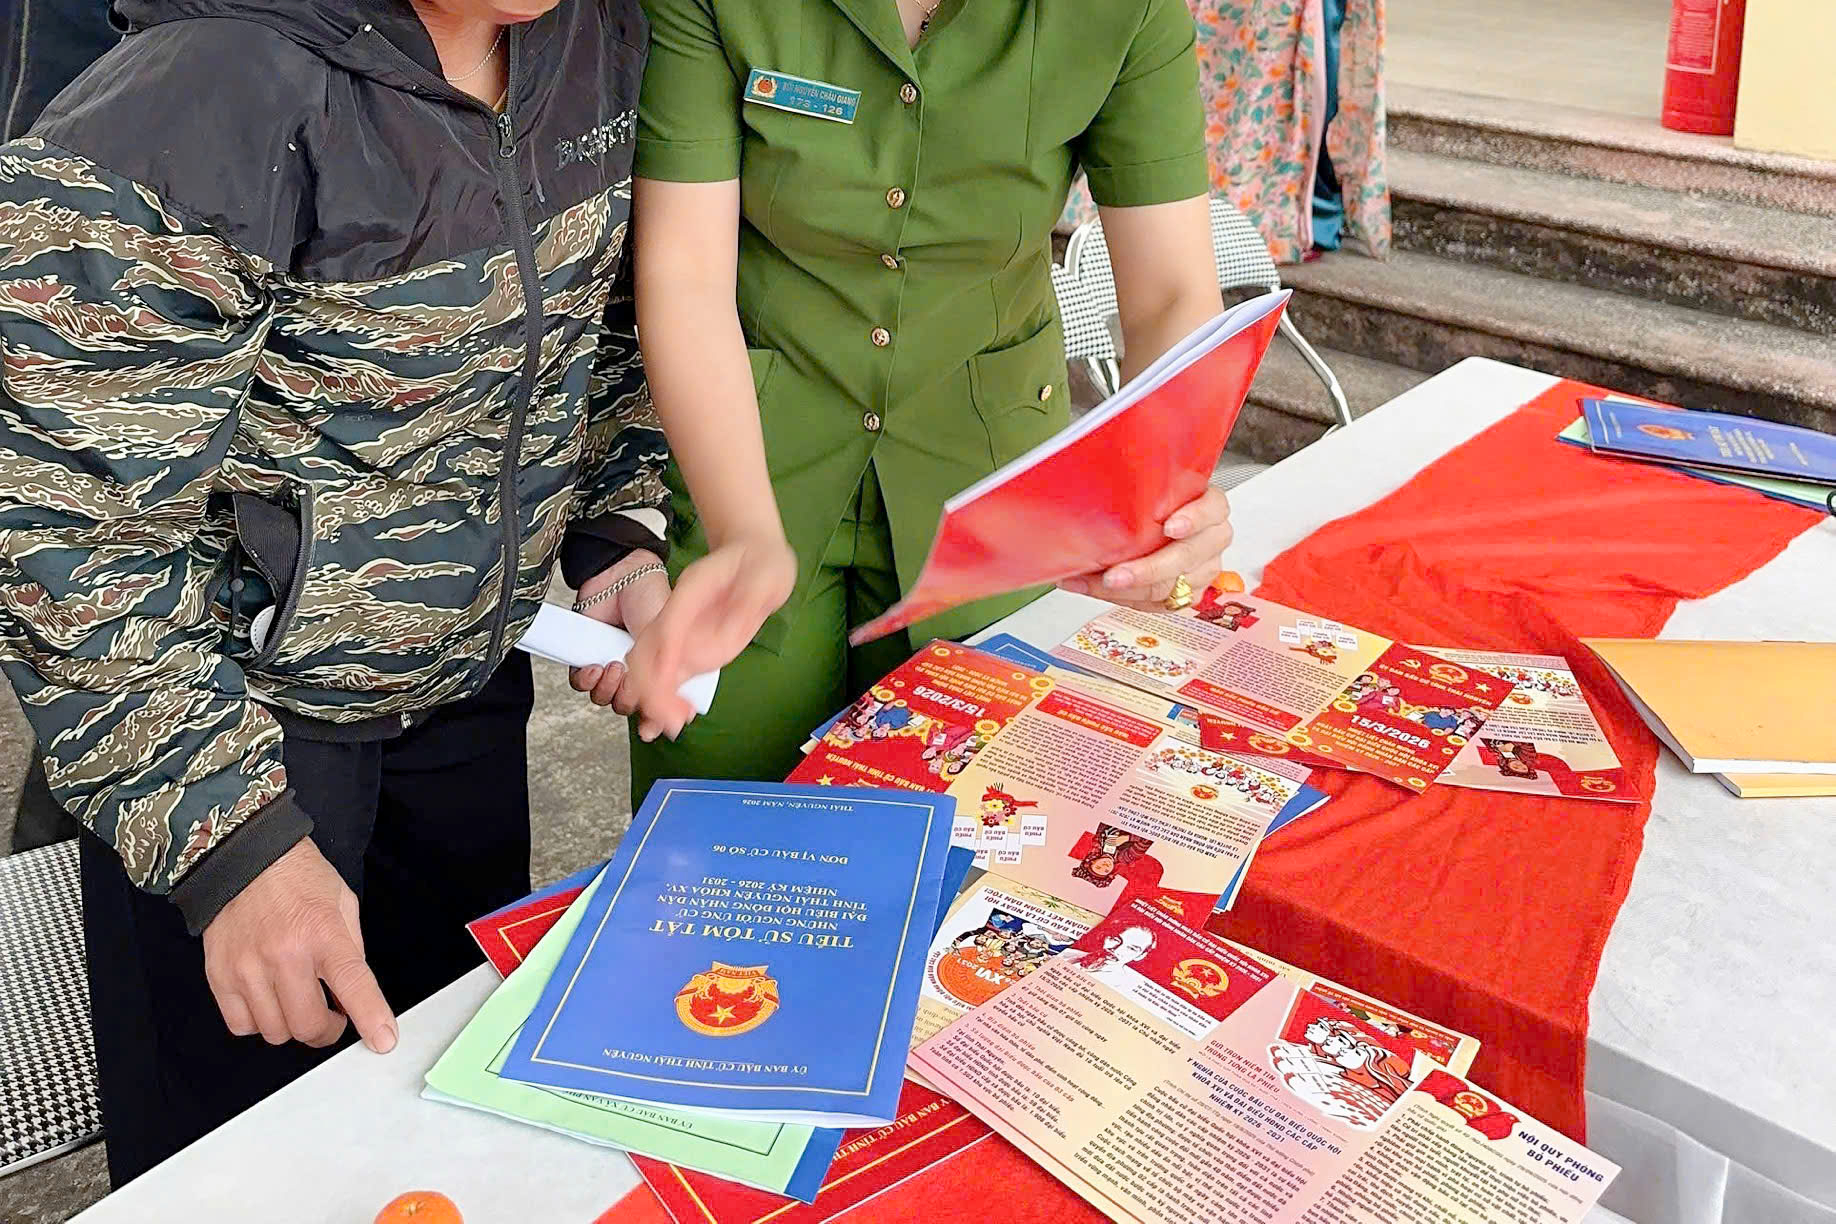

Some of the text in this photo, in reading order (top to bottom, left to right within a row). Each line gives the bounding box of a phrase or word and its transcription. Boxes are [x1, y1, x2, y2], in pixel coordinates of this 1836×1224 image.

[789, 95, 811, 108] 173
[822, 103, 844, 116] 126
[912, 685, 985, 717] 15/3/2026
[1351, 715, 1430, 749] 15/3/2026
[712, 844, 848, 864] ĐƠN VỊ BẦU CỬ SỐ 06
[701, 876, 728, 885] 2031
[737, 879, 765, 889] 2026
[766, 882, 787, 893] KỲ
[790, 884, 838, 896] NHIỆM
[691, 885, 731, 897] KHÓA
[734, 889, 792, 903] NGUYÊN
[794, 895, 829, 907] THÁI
[656, 894, 868, 921] ĐẠI BIỂU HỘI ĐỒNG NHÂN DÂN
[832, 899, 867, 911] TỈNH
[674, 907, 838, 931] NHỮNG NGƯỜI ỨNG CỬ
[648, 918, 854, 949] TIỂU SỬ TÓM TẮT
[602, 1047, 807, 1075] ỦY BAN BẦU CỬ TỈNH THÁI NGUYÊN
[1517, 1130, 1604, 1183] NỘI QUY PHÒNG
[1526, 1148, 1580, 1182] BỎ PHIẾU
